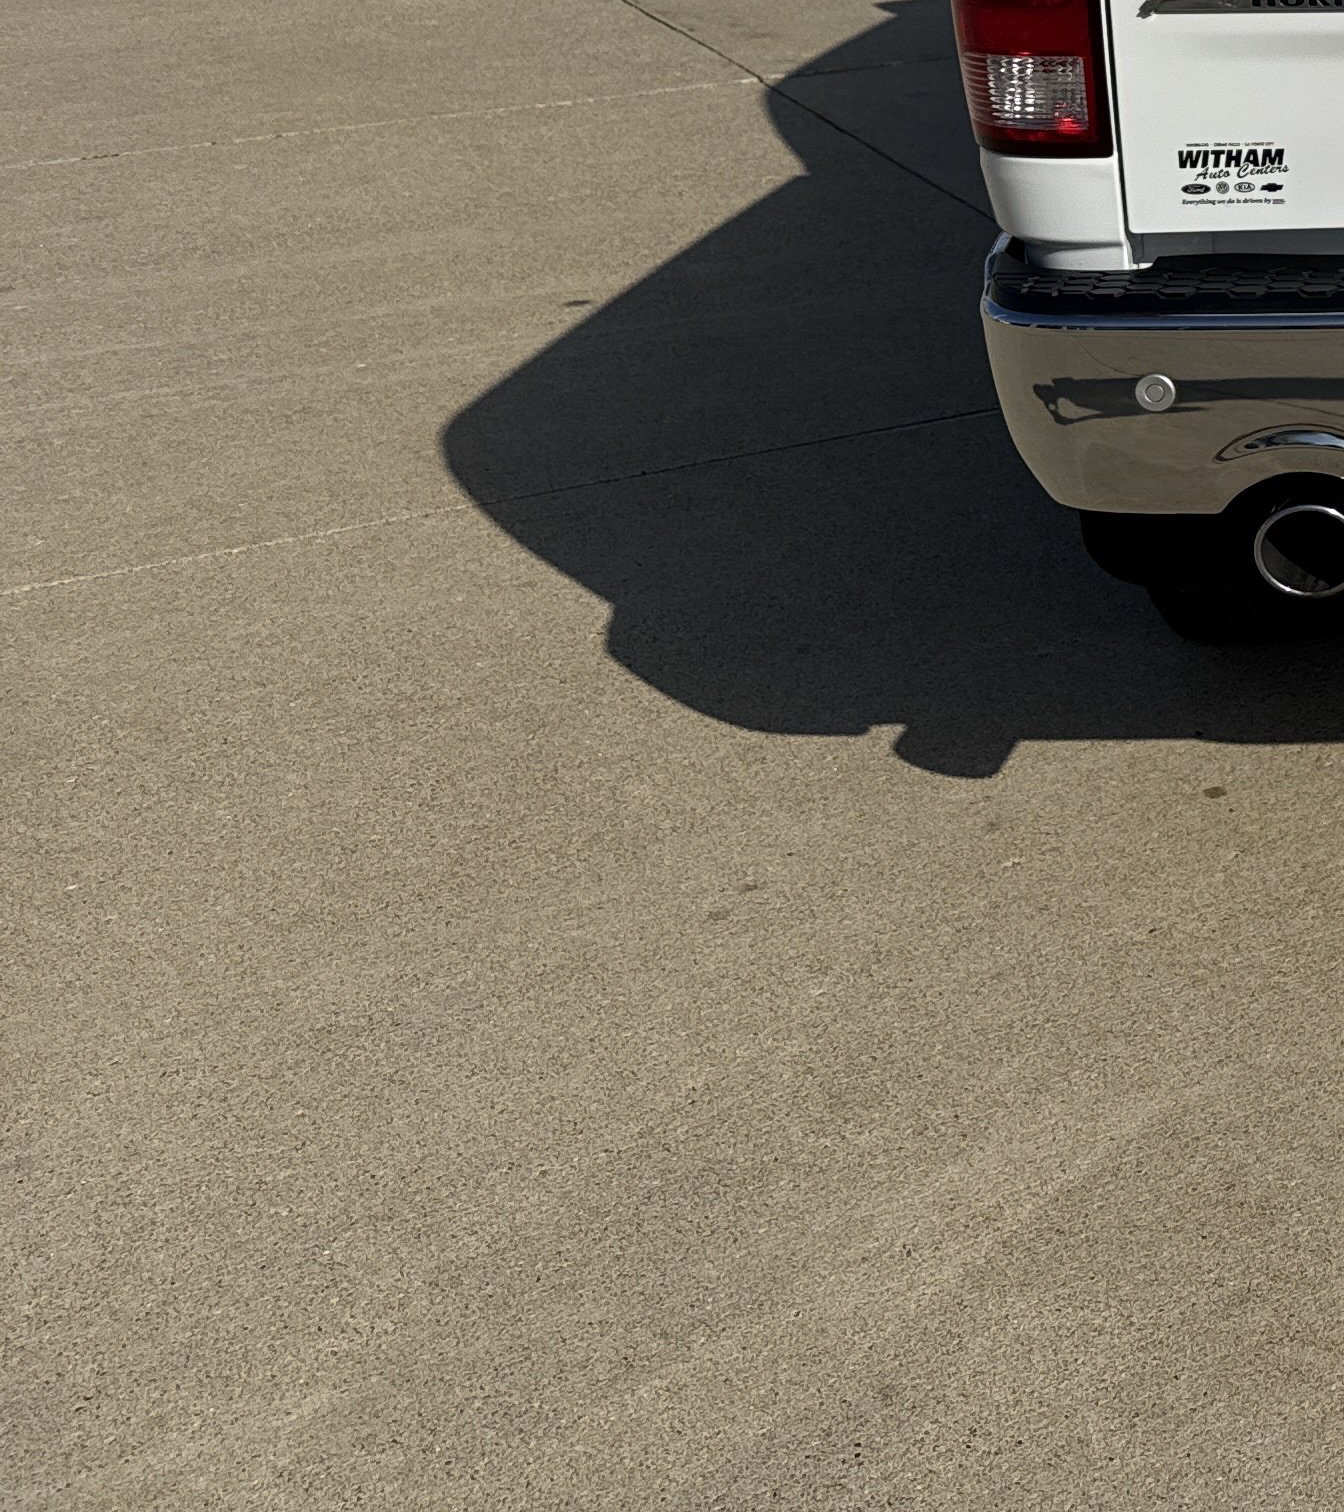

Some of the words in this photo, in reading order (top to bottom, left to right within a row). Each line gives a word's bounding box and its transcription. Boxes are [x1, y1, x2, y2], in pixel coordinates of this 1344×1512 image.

[1178, 148, 1286, 169] WITHAM
[1194, 167, 1231, 181] Auto
[1236, 162, 1289, 178] Centers
